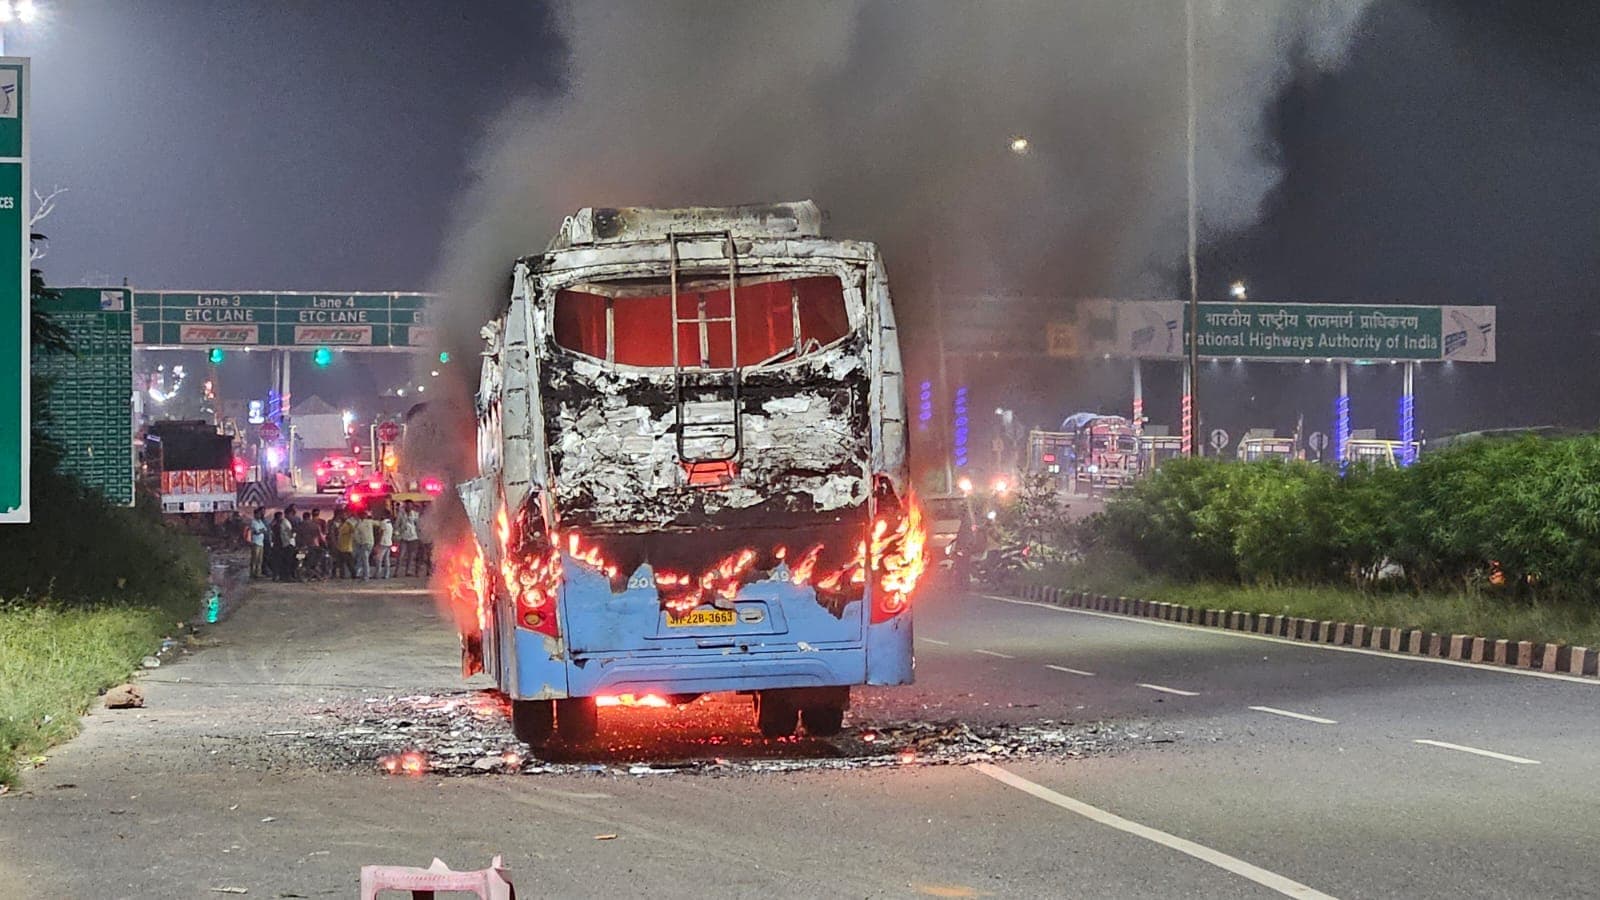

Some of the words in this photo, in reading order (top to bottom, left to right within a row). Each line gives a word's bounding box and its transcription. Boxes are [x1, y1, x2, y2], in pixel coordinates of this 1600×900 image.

[197, 295, 228, 306] Lane
[232, 295, 240, 306] 3
[313, 296, 342, 308] Lane
[346, 296, 355, 307] 4
[185, 309, 213, 320] ETC
[216, 309, 254, 321] LANE
[300, 311, 326, 322] ETC
[331, 311, 367, 322] LANE
[1205, 309, 1251, 327] भारतीय
[1258, 309, 1298, 329] राष्ट्रीय
[1305, 311, 1353, 329] राजमार्ग
[1360, 311, 1419, 330] प्राधिकरण
[1249, 332, 1313, 350] Highways
[1319, 334, 1382, 351] Authority
[1386, 334, 1400, 349] of
[1404, 335, 1438, 349] India
